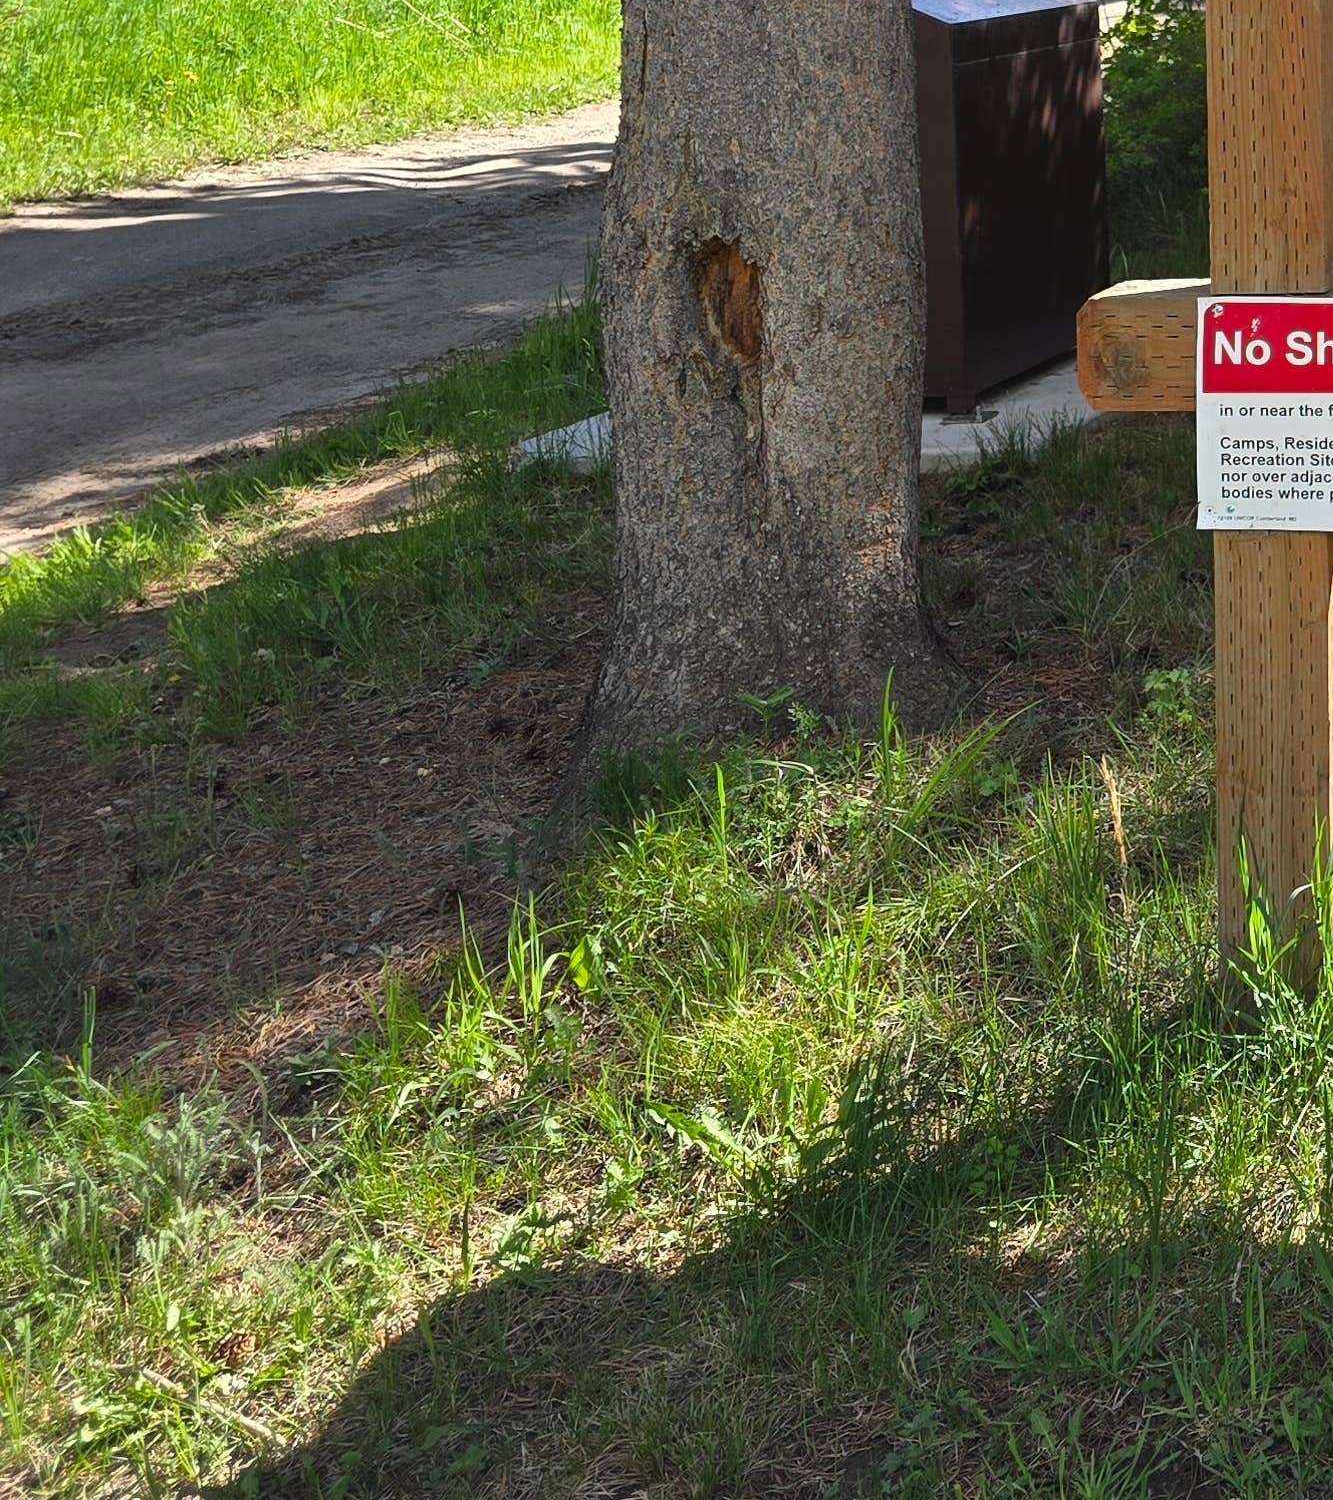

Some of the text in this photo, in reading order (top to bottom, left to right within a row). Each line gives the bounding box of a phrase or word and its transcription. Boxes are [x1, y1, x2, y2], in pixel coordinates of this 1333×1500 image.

[1214, 331, 1271, 366] No
[1219, 405, 1233, 416] in
[1239, 405, 1255, 417] or
[1260, 406, 1293, 417] near
[1299, 405, 1323, 417] the
[1220, 438, 1279, 451] Camps,
[1221, 453, 1305, 466] Recreation
[1222, 472, 1247, 482] nor
[1252, 472, 1286, 483] over
[1222, 487, 1272, 499] bodies
[1278, 488, 1324, 500] where
